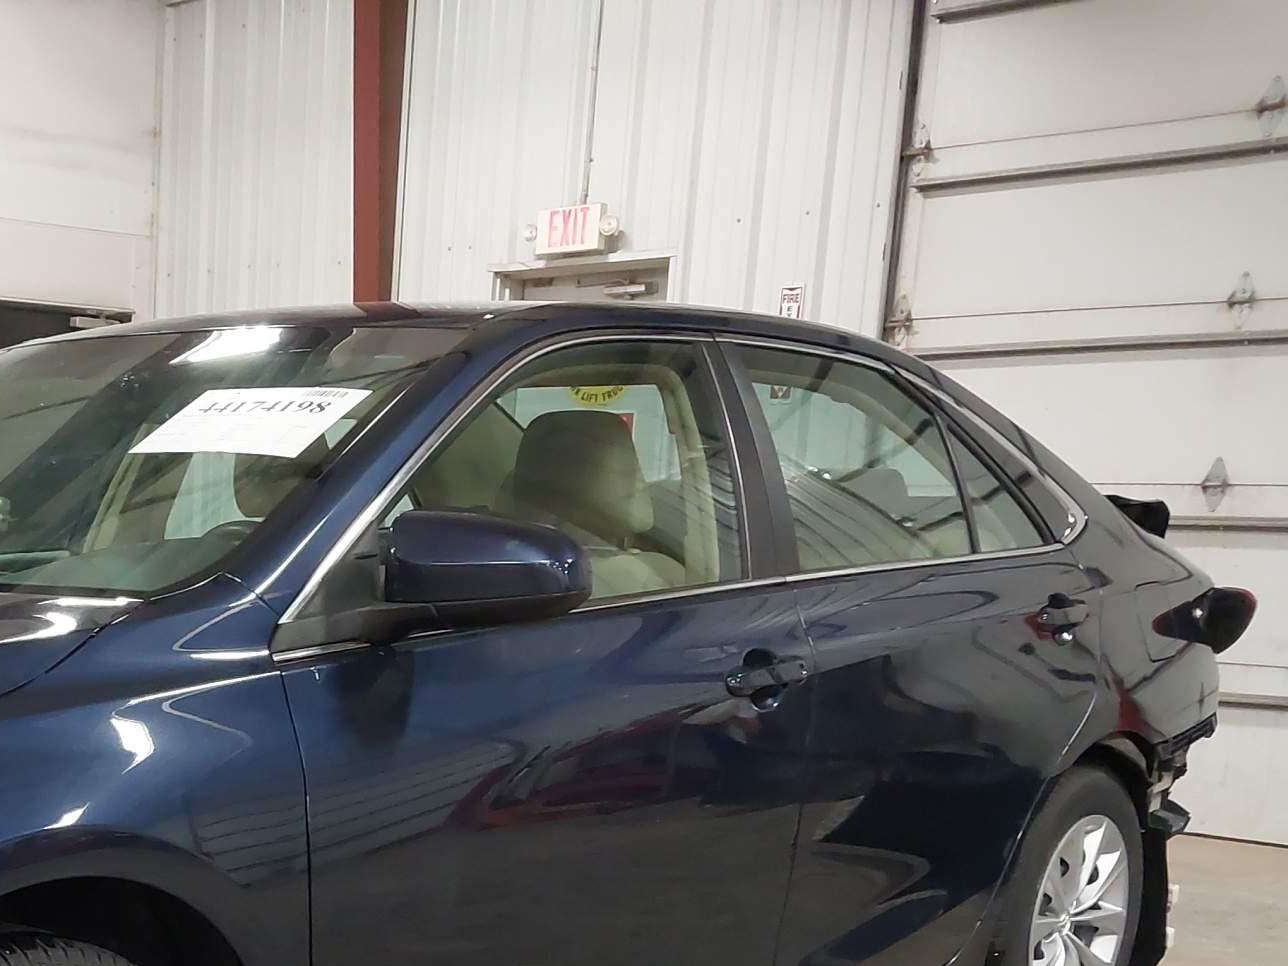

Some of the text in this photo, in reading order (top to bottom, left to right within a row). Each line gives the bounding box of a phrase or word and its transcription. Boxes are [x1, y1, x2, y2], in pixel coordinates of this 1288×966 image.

[548, 206, 589, 248] EXIT
[783, 293, 800, 304] FIRE
[198, 400, 332, 413] 44174198
